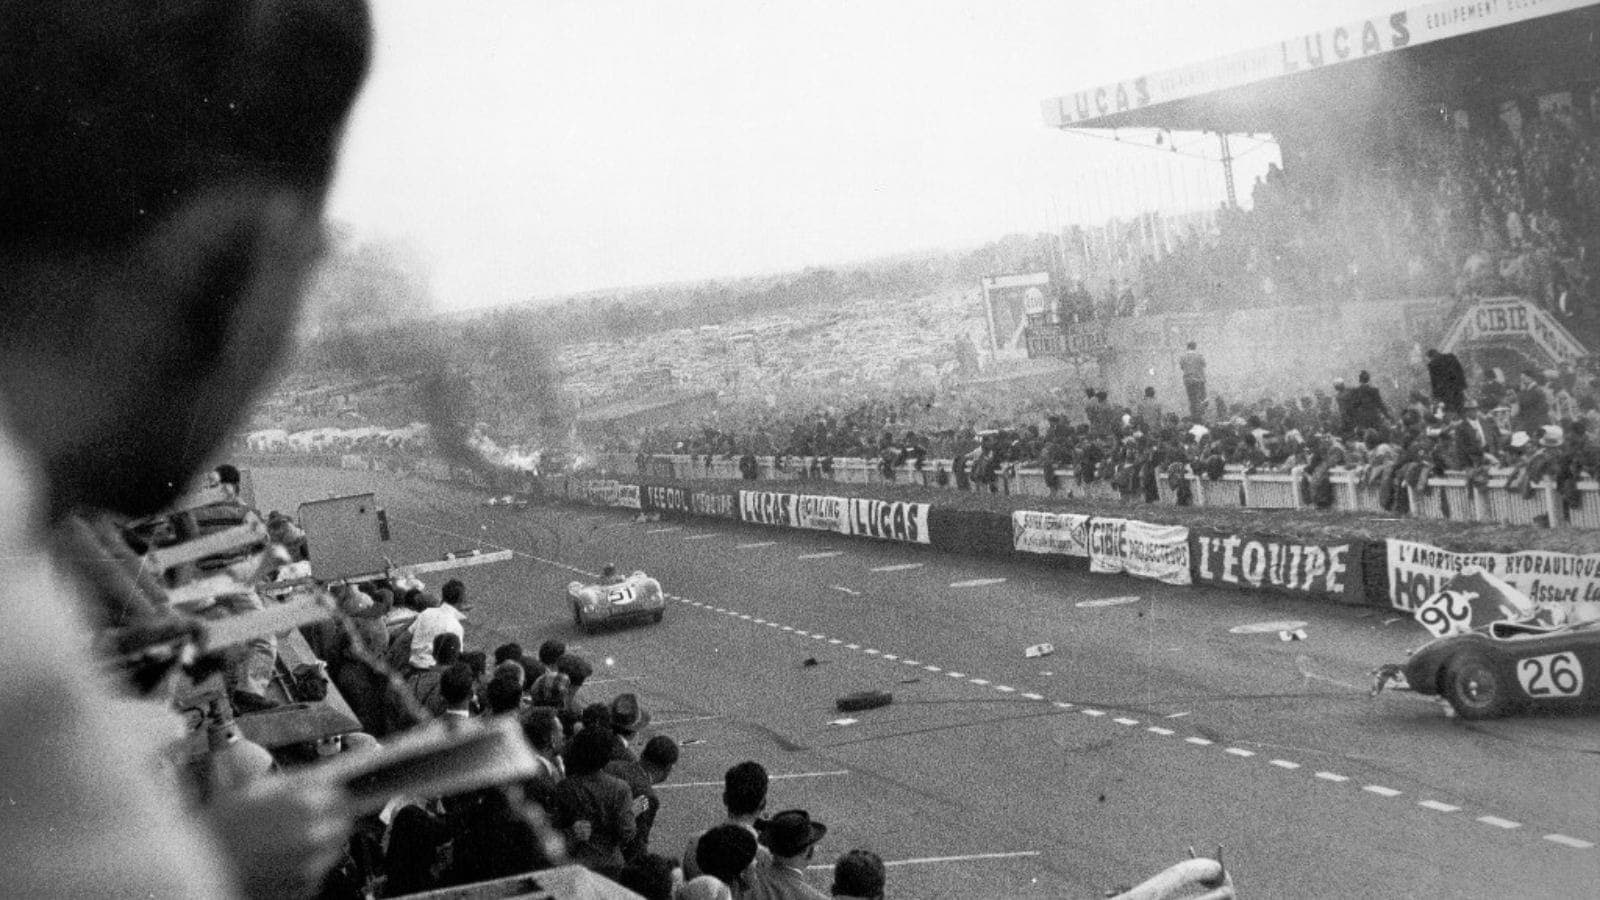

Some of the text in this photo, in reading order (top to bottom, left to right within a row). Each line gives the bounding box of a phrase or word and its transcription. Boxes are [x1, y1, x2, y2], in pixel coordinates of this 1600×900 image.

[1282, 11, 1410, 71] LUCAS
[1059, 75, 1150, 123] LUCAS
[744, 493, 791, 526] LUCAS
[855, 499, 918, 541] LUCAS
[1530, 580, 1579, 602] Assure
[1523, 655, 1578, 694] 26
